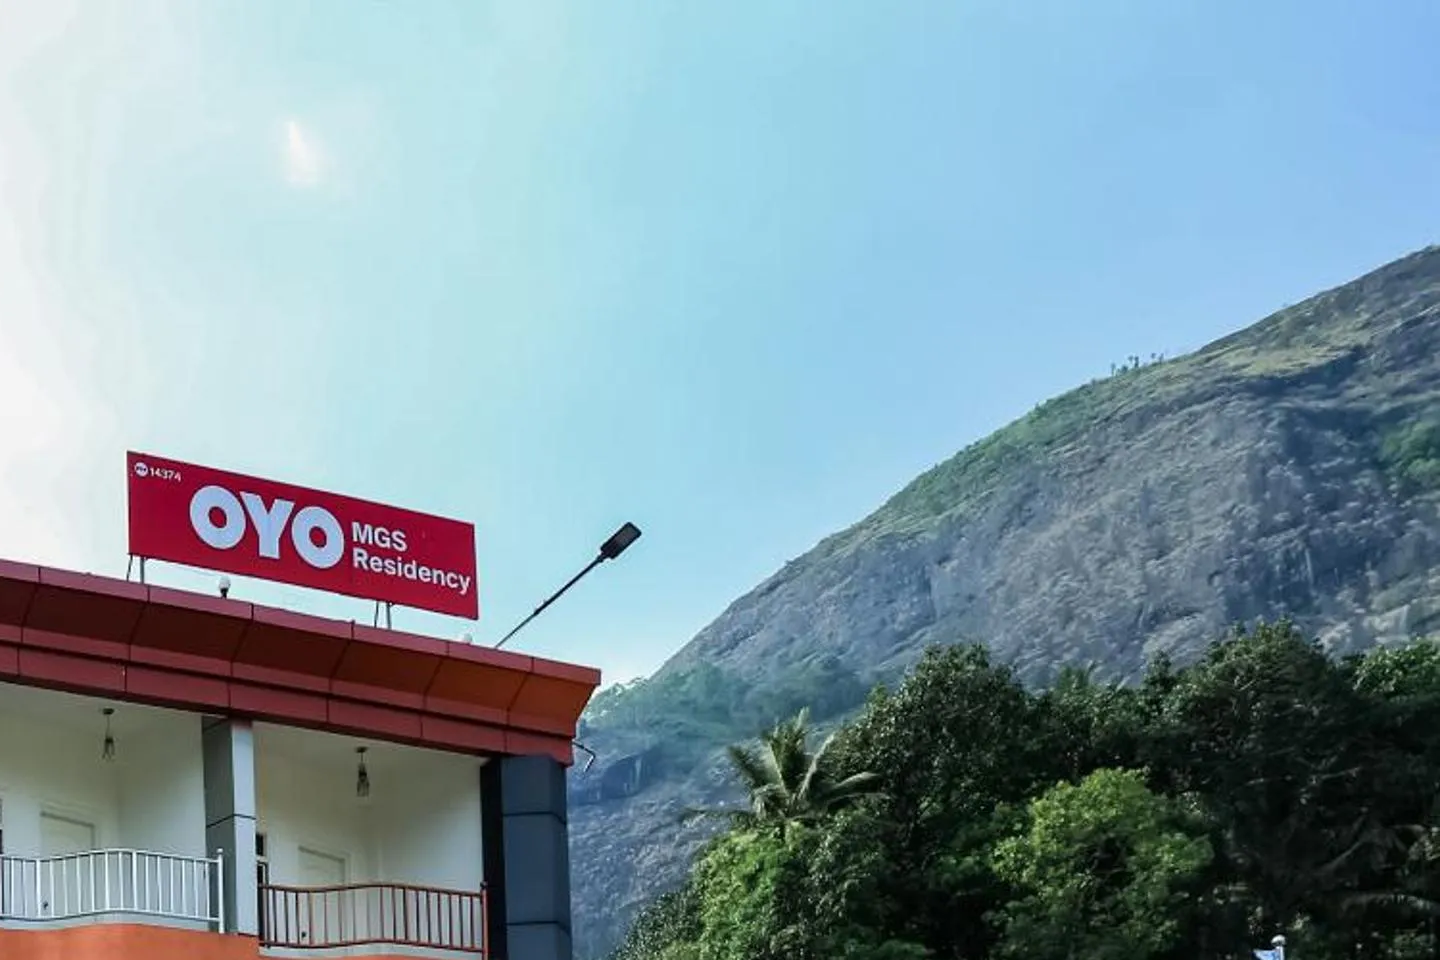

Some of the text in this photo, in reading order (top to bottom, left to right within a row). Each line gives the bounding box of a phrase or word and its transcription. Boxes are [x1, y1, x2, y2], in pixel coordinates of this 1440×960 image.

[190, 485, 344, 568] OYO
[351, 521, 408, 552] MGS
[352, 549, 471, 595] Residency
